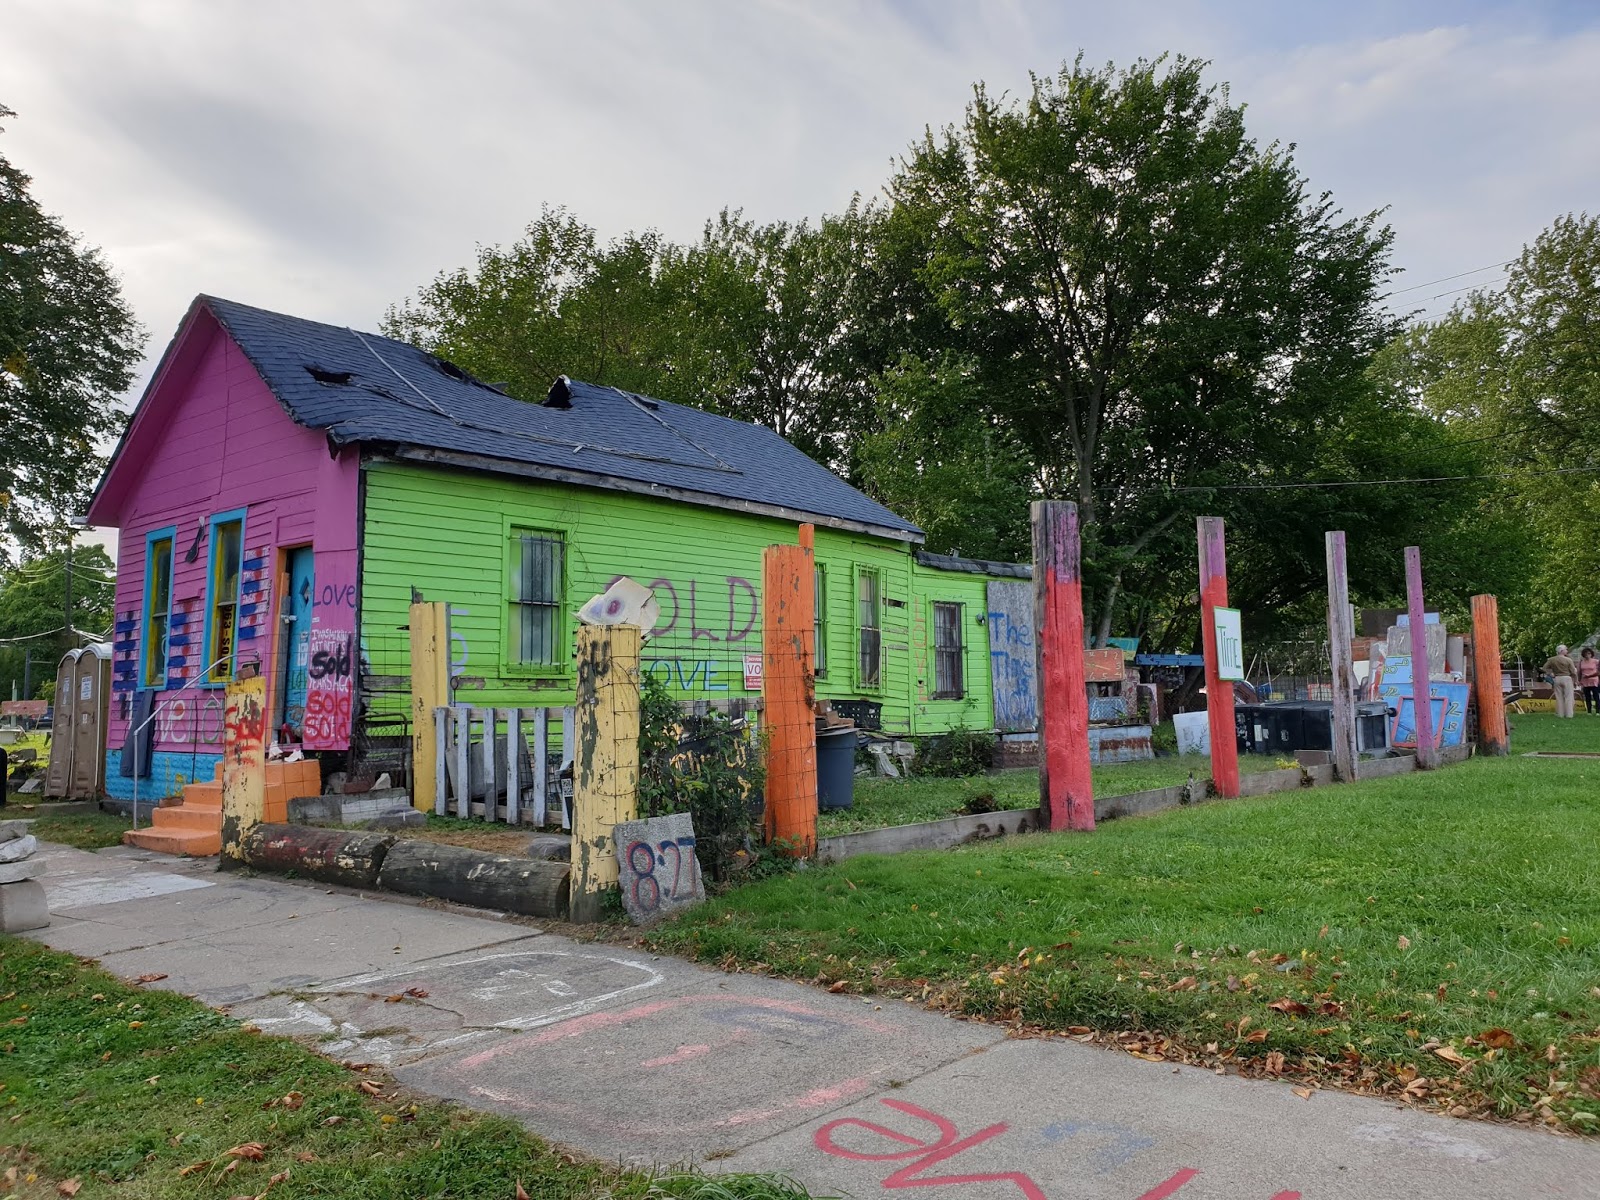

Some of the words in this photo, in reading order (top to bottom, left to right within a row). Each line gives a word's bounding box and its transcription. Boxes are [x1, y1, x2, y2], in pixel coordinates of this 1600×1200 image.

[313, 573, 356, 608] Love
[606, 576, 757, 641] OLD
[989, 612, 1031, 646] The
[311, 641, 323, 653] ART
[330, 641, 346, 655] THS
[641, 660, 728, 690] OVE
[996, 689, 1035, 721] NOW
